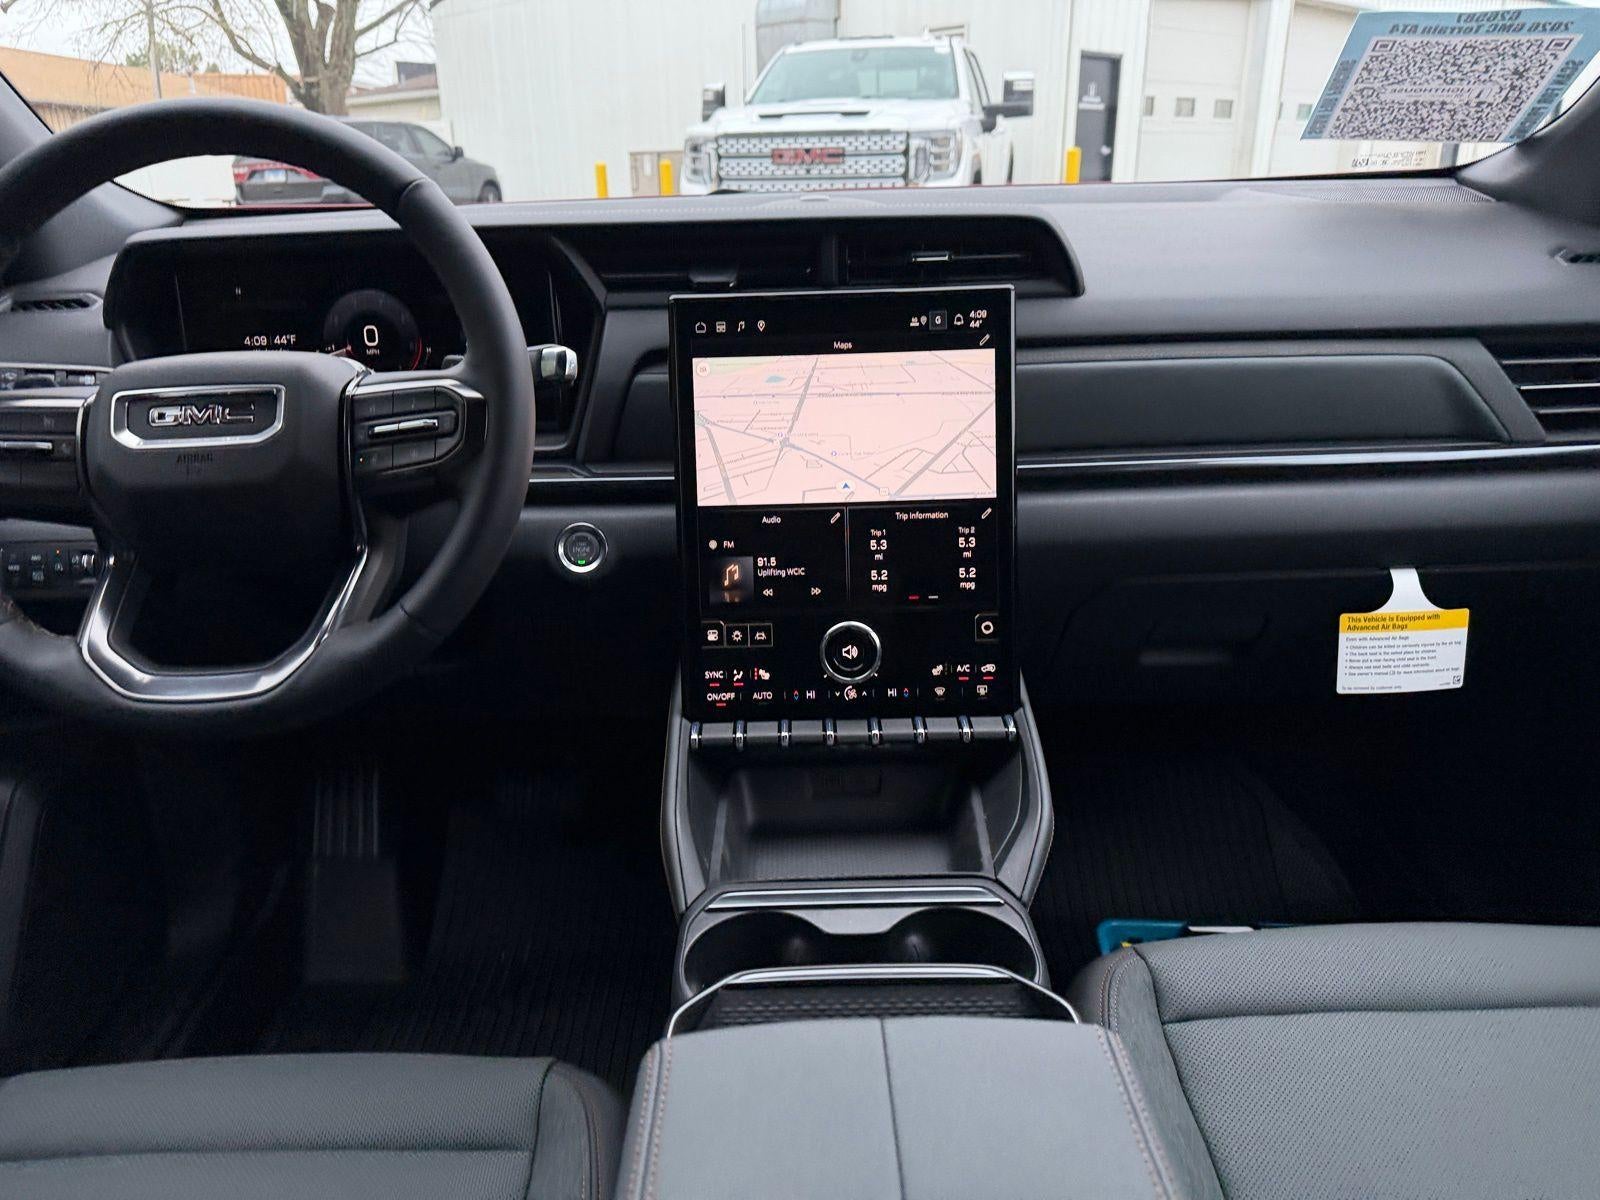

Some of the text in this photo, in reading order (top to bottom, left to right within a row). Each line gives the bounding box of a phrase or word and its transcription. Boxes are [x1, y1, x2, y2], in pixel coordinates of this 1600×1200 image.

[771, 147, 846, 165] GMC
[244, 334, 296, 346] 4:09 44°F
[363, 325, 379, 347] 0
[833, 341, 853, 350] Maps
[366, 348, 380, 356] MPH
[149, 403, 255, 427] GMC
[761, 515, 782, 525] Audio
[895, 510, 949, 521] Trip Information
[870, 529, 881, 537] Trip
[958, 526, 969, 535] Trip
[723, 540, 735, 549] FM
[870, 539, 888, 551] 5.3
[958, 537, 976, 548] 5.3
[757, 556, 777, 567] 91.5
[757, 568, 786, 578] Uplifting
[870, 569, 888, 581] 5.2
[958, 567, 976, 578] 5.2
[872, 583, 888, 593] mpg
[959, 580, 976, 590] mpg
[1396, 614, 1425, 623] Equipped
[1347, 623, 1380, 631] Advanced
[1392, 623, 1408, 631] Bags
[956, 664, 970, 673] A/C
[705, 670, 724, 680] SYNC
[706, 691, 736, 701] ON/OFF
[752, 691, 773, 700] AUTO
[806, 690, 816, 699] HI
[887, 688, 898, 698] HI
